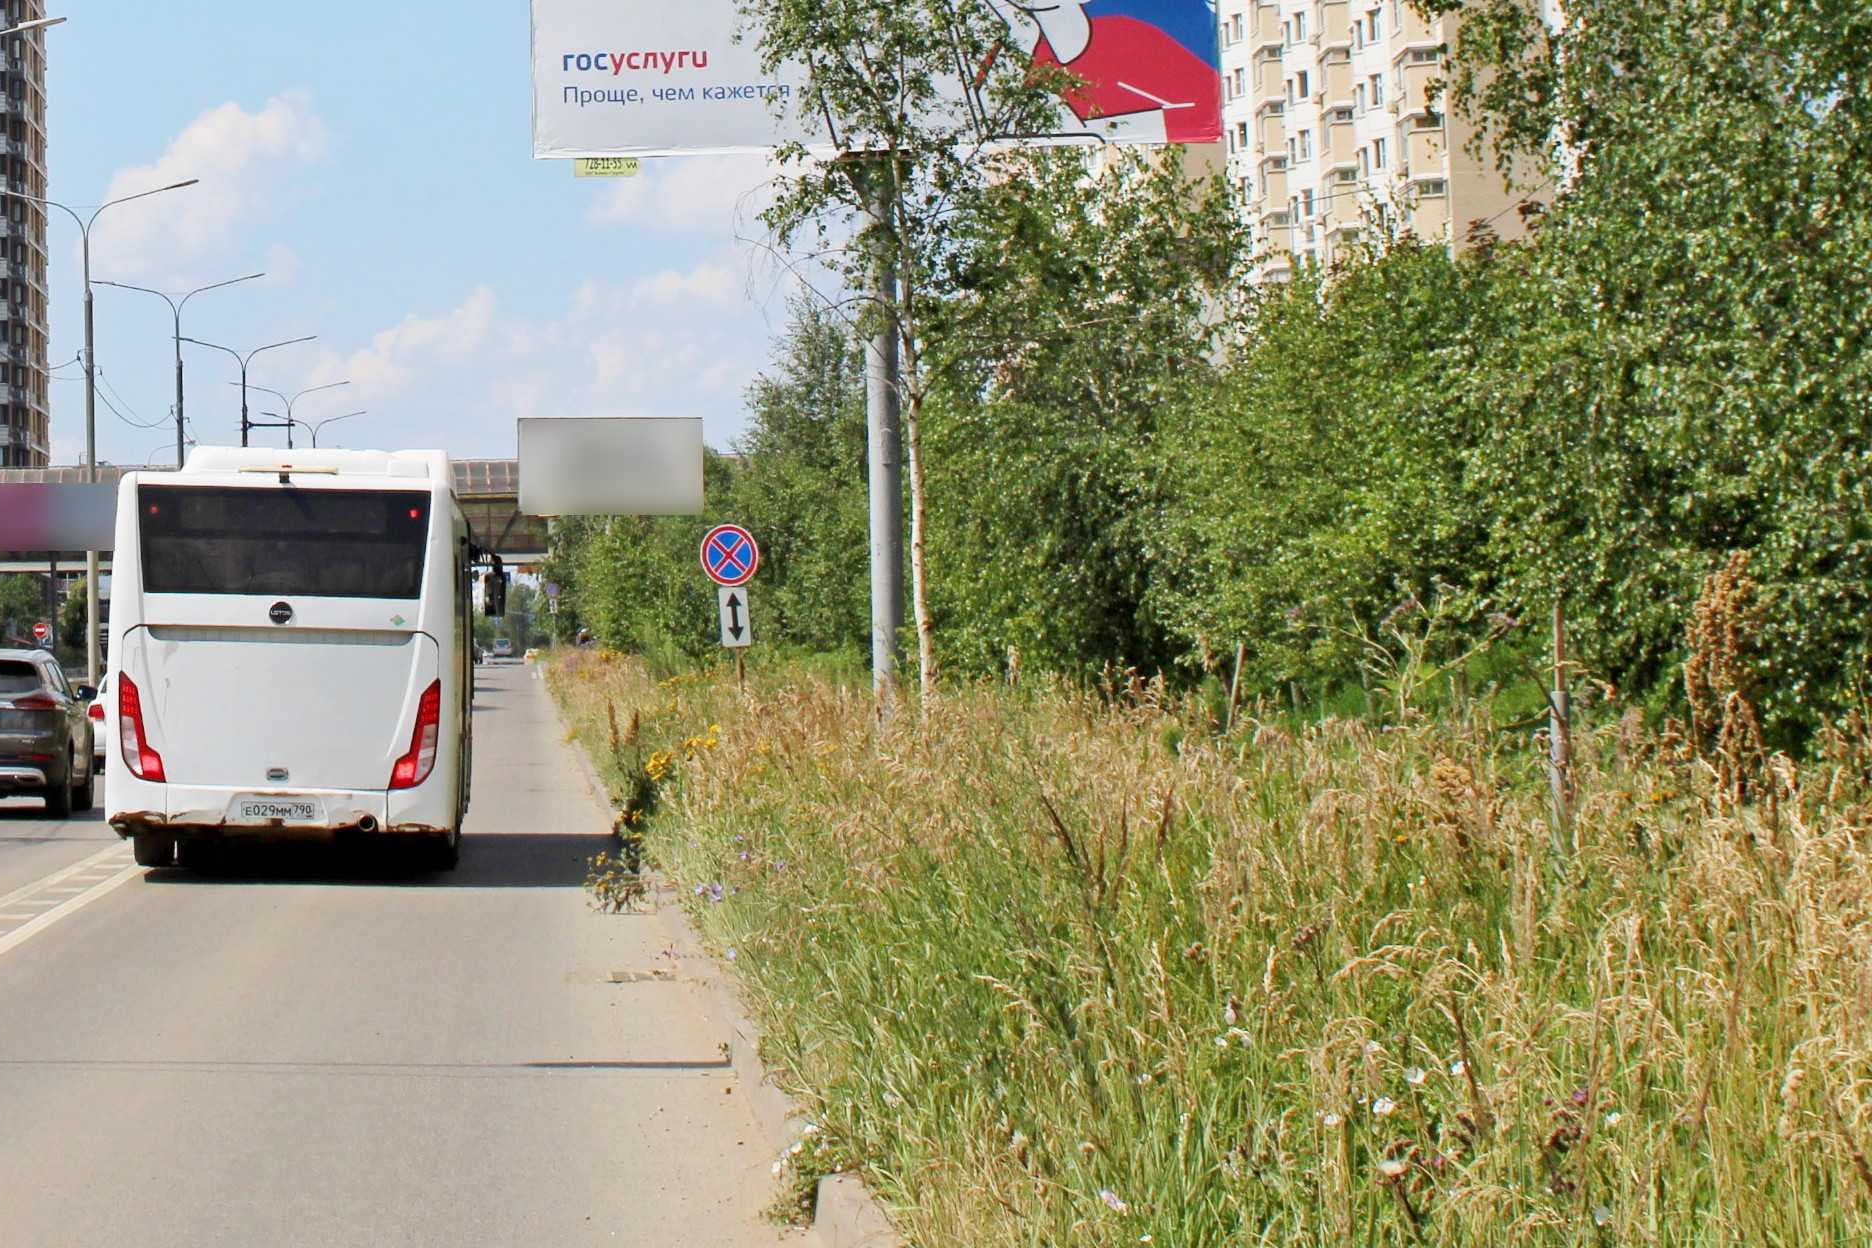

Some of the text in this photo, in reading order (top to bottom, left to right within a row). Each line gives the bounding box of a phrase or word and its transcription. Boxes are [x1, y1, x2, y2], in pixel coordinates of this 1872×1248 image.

[562, 51, 708, 74] госуслуги
[563, 86, 645, 107] Проще,
[651, 87, 694, 102] чем
